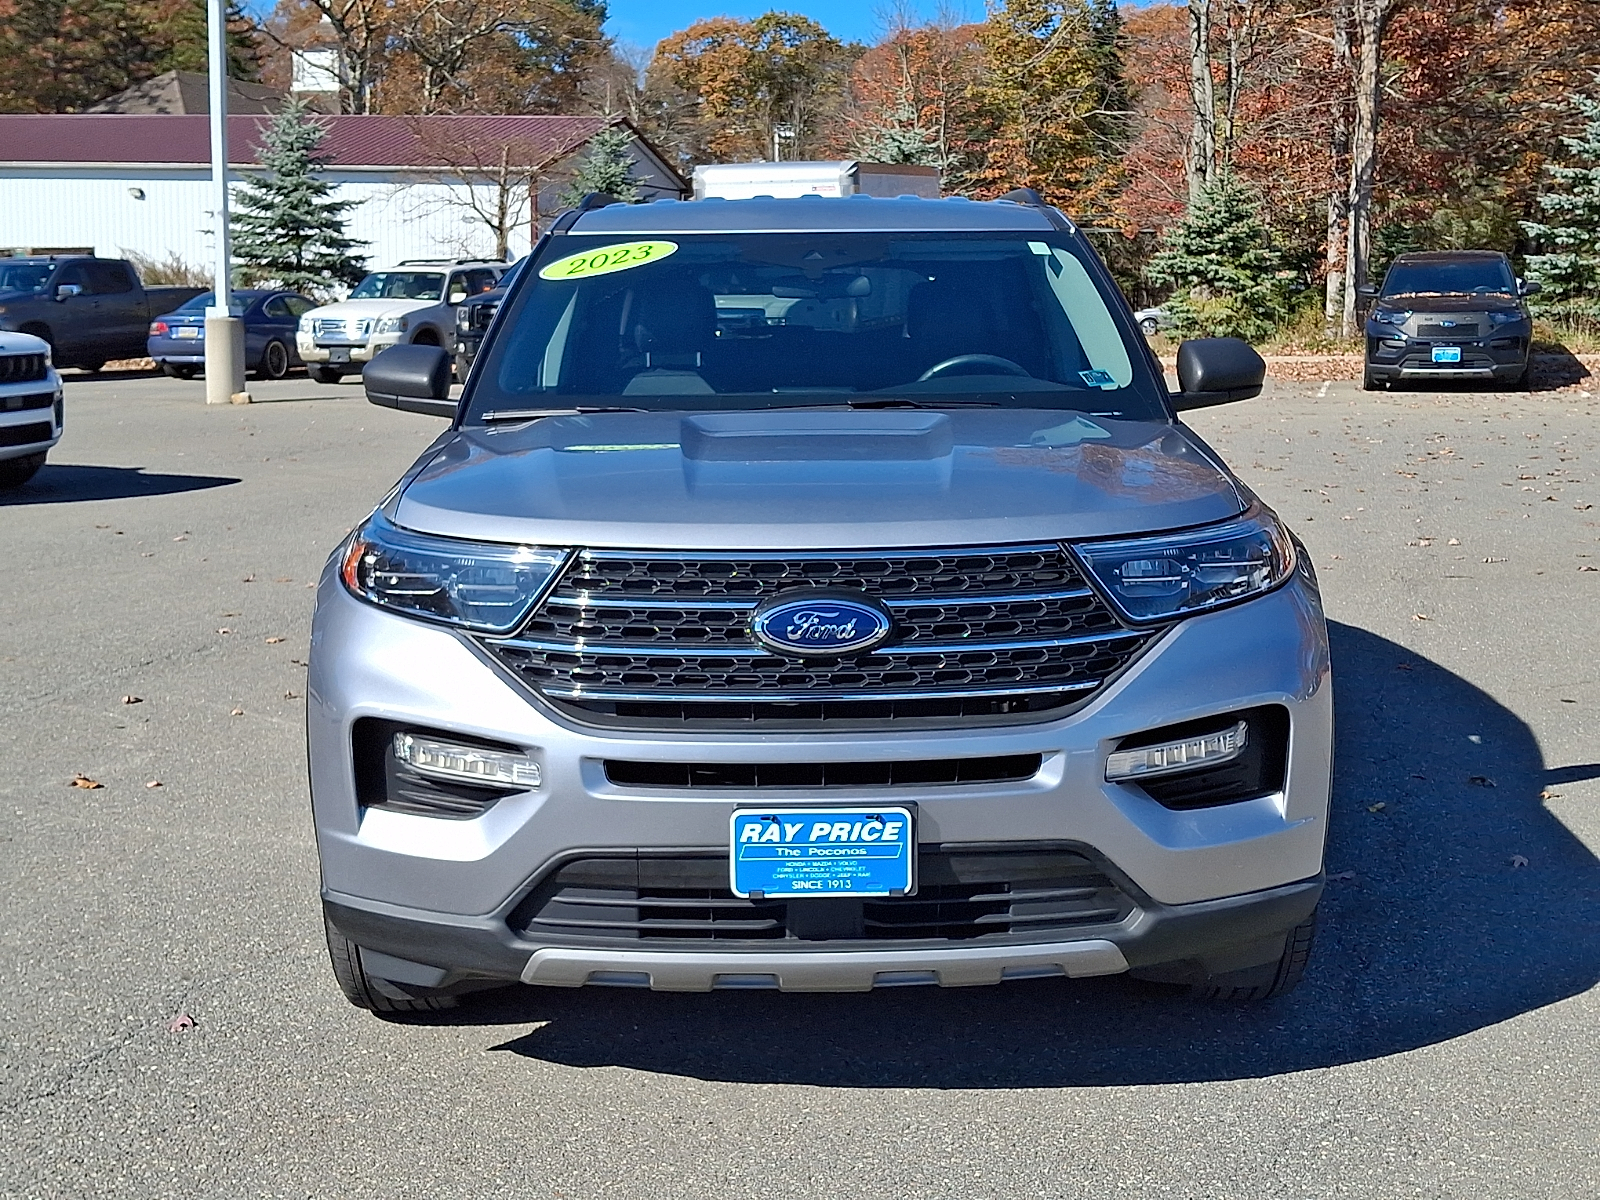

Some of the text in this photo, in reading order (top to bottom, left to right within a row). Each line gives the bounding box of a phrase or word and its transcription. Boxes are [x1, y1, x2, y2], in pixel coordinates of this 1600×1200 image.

[566, 244, 654, 276] 2023
[787, 610, 858, 640] Ford
[739, 821, 903, 843] RAY PRICE
[775, 847, 867, 857] The Poconos
[791, 879, 852, 890] SINCE 1913
